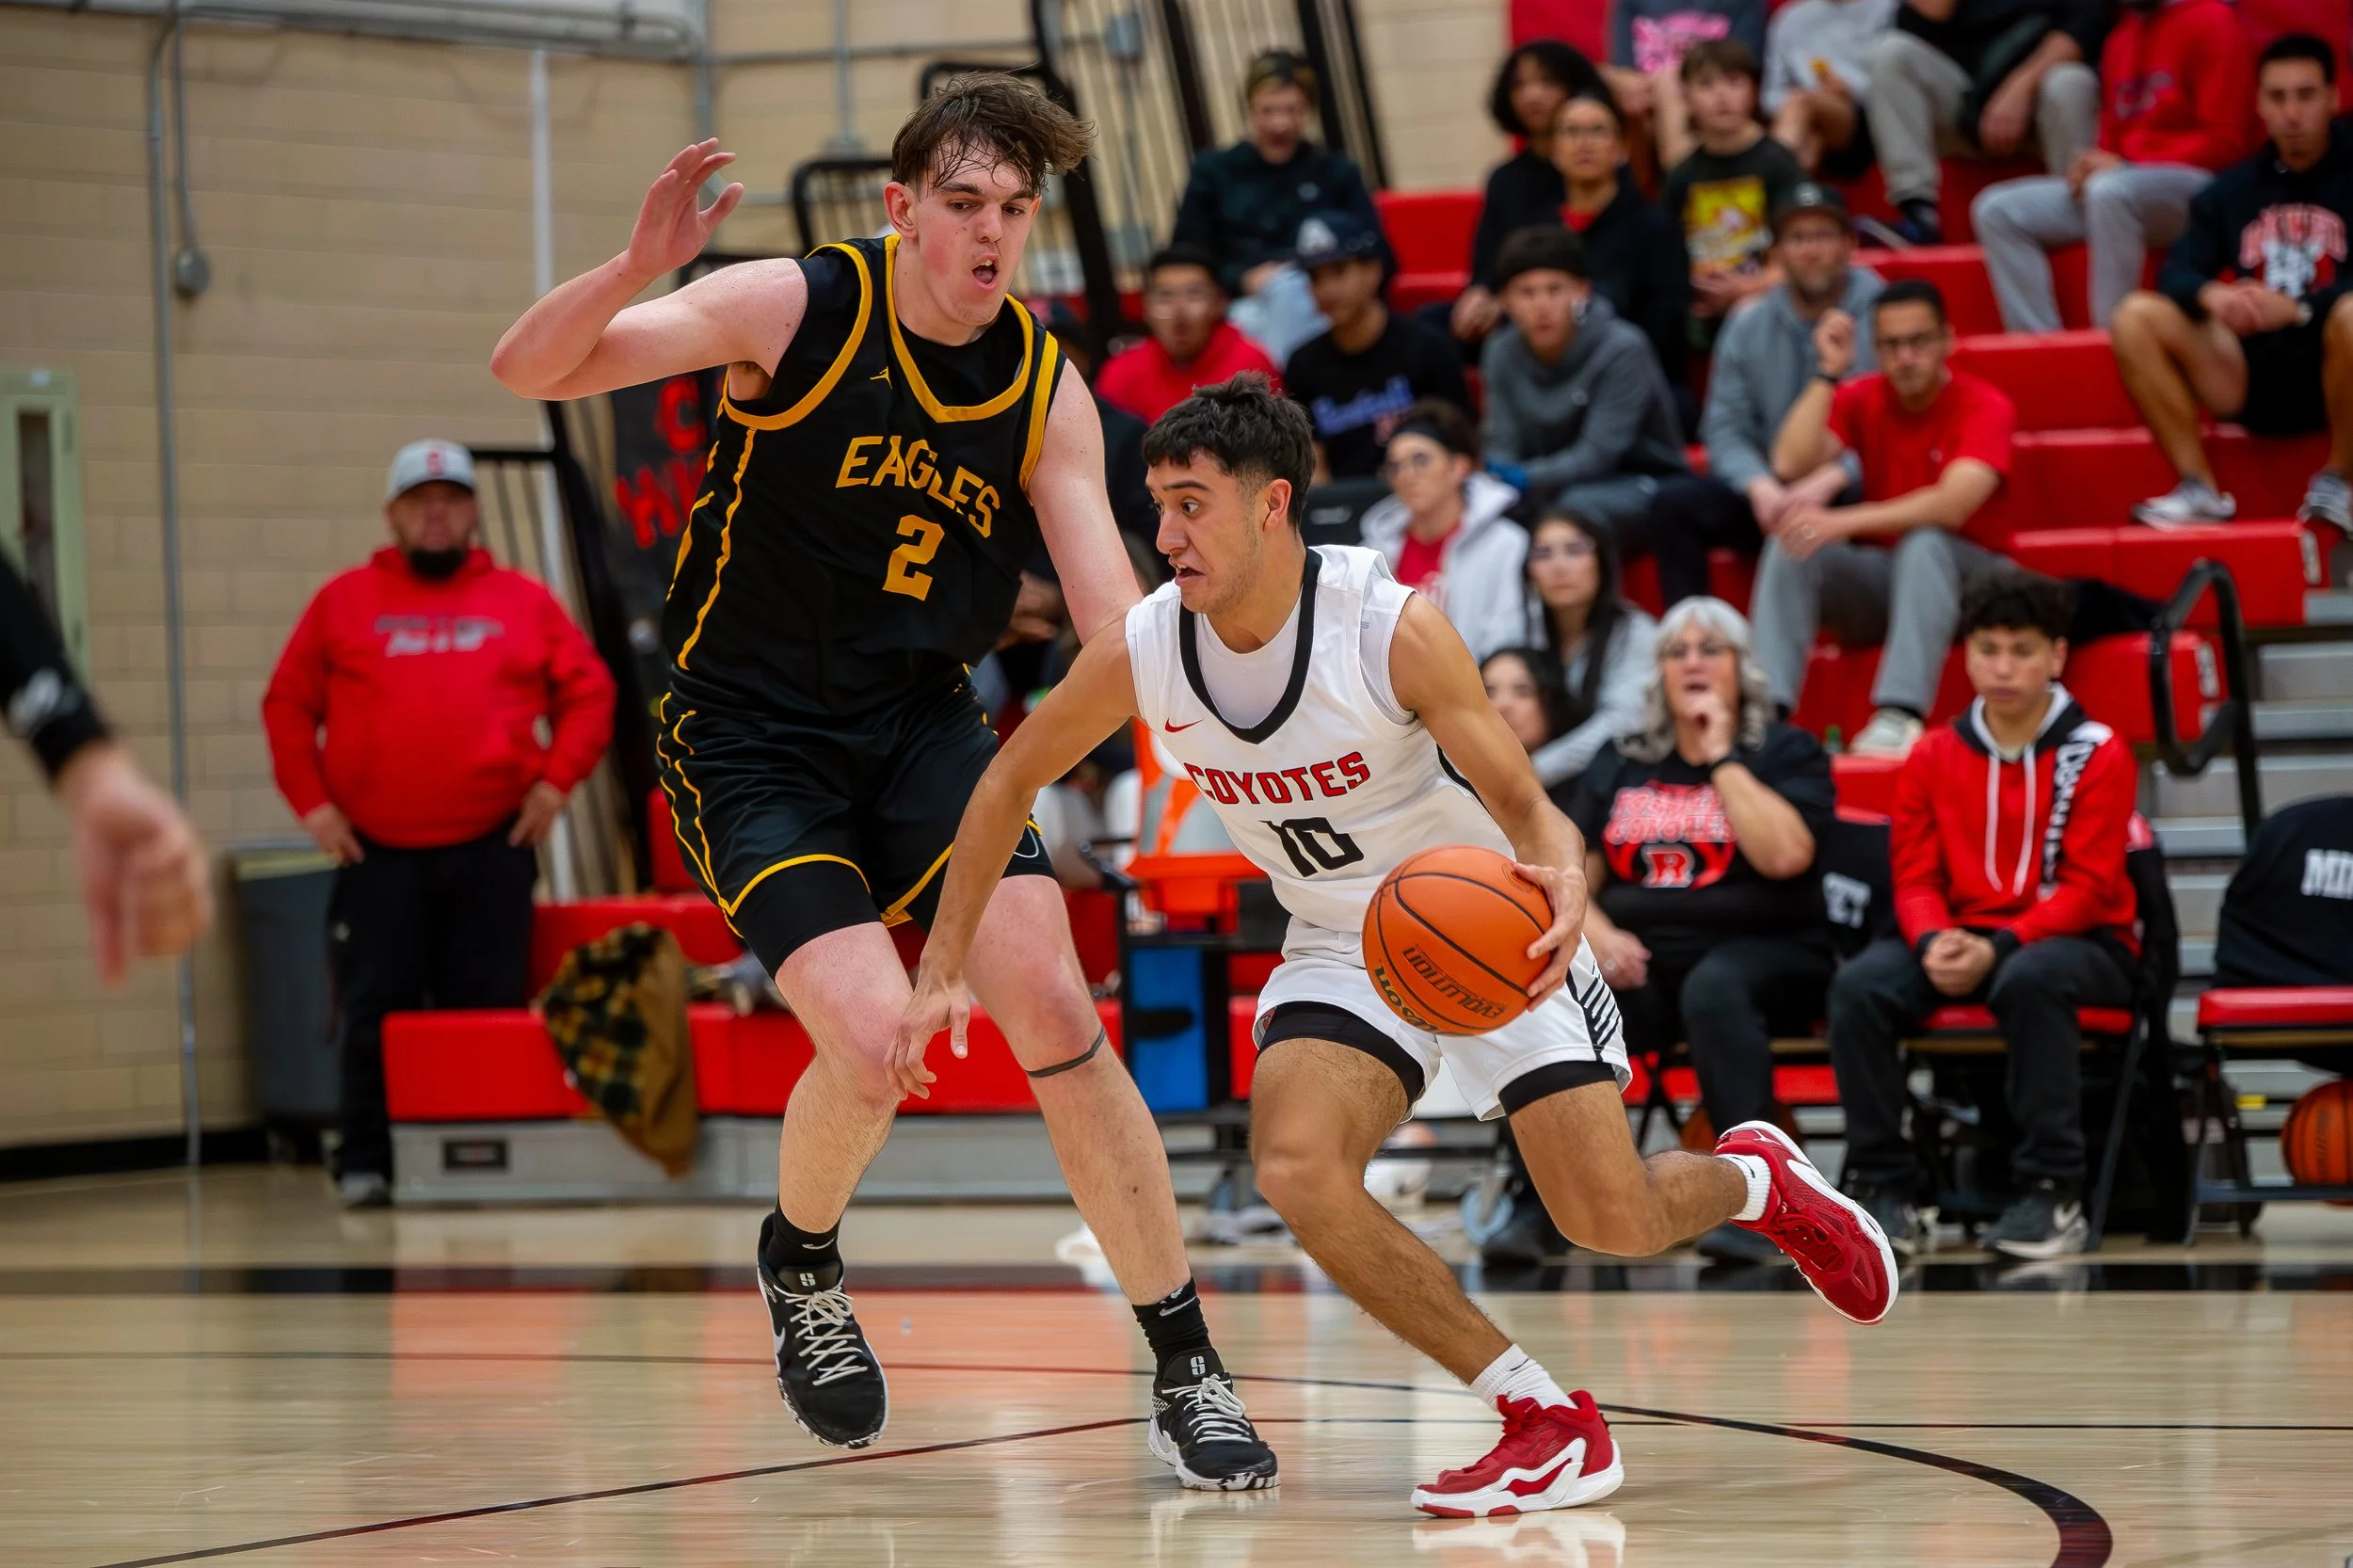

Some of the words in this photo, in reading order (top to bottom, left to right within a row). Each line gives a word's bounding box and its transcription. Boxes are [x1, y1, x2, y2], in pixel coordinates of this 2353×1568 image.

[835, 435, 1000, 538] EAGLES
[882, 514, 945, 601] 2
[1183, 751, 1371, 805] COYOTES
[1257, 816, 1365, 878] 10
[1402, 946, 1505, 1019] EVOLUTION
